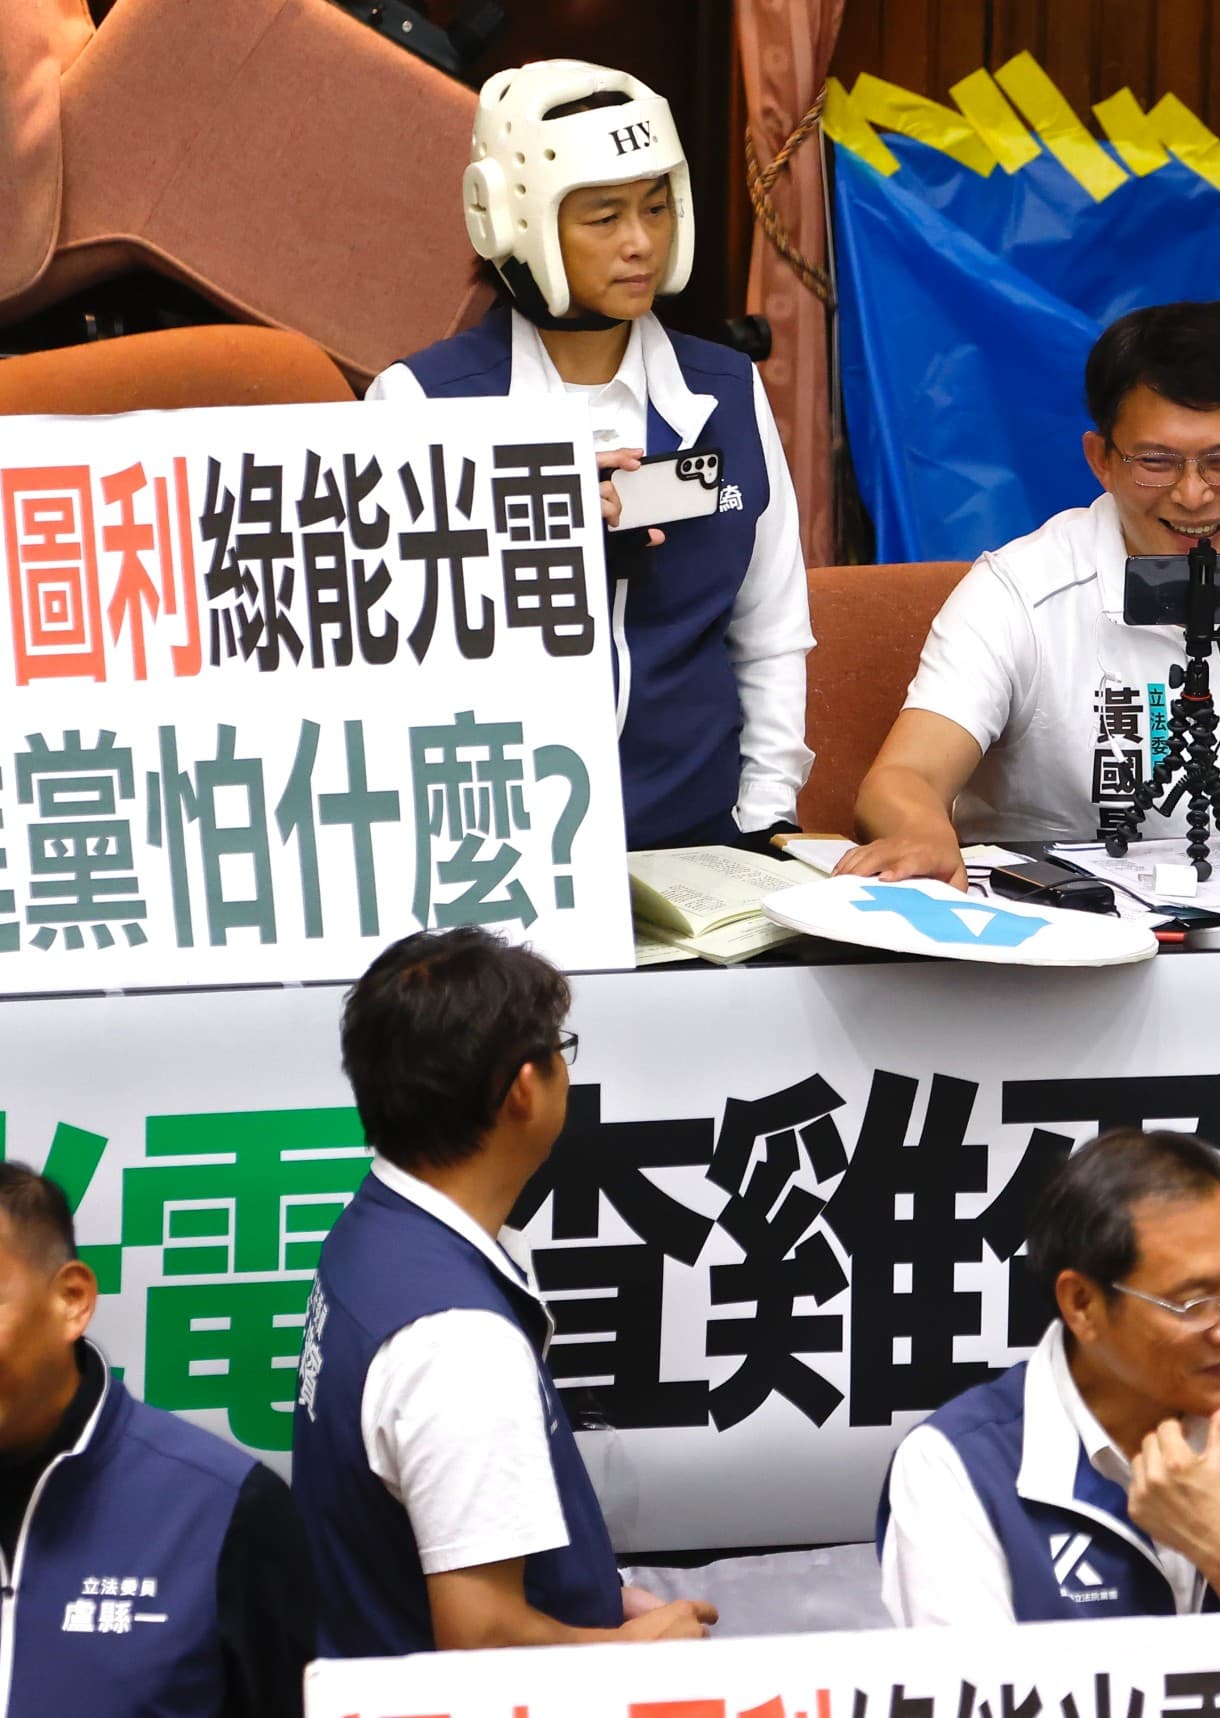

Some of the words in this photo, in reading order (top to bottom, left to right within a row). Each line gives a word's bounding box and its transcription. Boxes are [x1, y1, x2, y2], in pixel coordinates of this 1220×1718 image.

[0, 442, 595, 686] 圖利綠能光電
[1149, 687, 1169, 772] 立法委
[0, 709, 592, 952] 黨怕什麼?
[61, 1598, 168, 1634] 盧縣一
[81, 1576, 157, 1597] 立法委員
